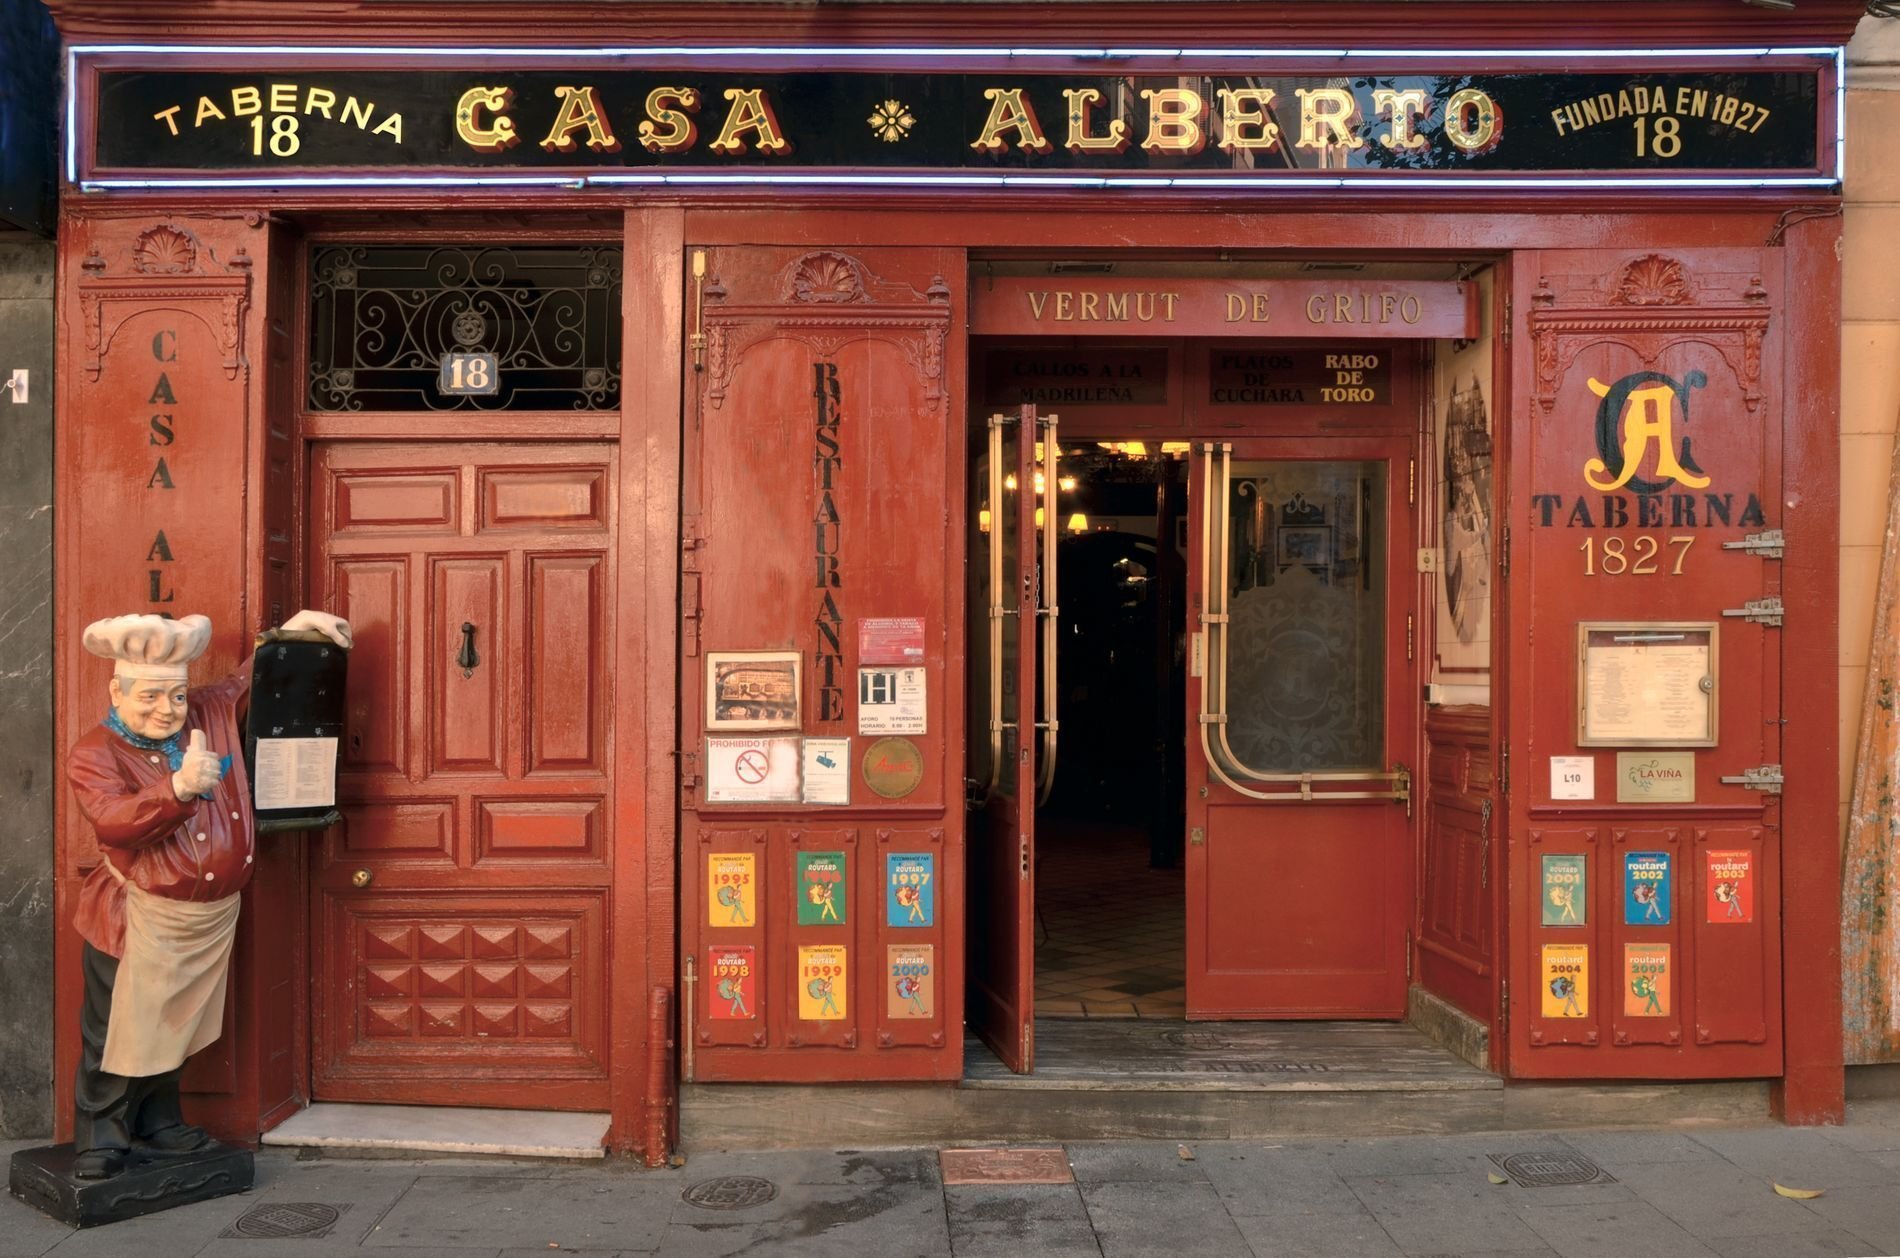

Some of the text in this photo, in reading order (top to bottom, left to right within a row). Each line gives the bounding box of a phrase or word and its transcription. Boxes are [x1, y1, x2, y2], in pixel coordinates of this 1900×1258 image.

[153, 84, 402, 144] TABERNA
[1551, 86, 1770, 136] FUNDADA EN 1827
[456, 86, 1503, 155] CASA ALBERTO
[250, 114, 300, 157] 18
[1633, 116, 1682, 158] 18
[1027, 291, 1423, 325] VERMUT DE GRIFO
[1325, 355, 1379, 370] RABO
[451, 358, 489, 389] 18
[1099, 363, 1113, 378] A
[1119, 363, 1142, 379] LA
[1336, 371, 1363, 385] DE
[1244, 373, 1270, 387] DE
[1214, 388, 1305, 402] CUCHARA
[1320, 388, 1375, 402] TORO
[146, 330, 178, 620] CASA AL
[1532, 492, 1766, 528] TABERNA
[813, 363, 844, 722] RESTAURANTE
[1580, 536, 1696, 576] 1827
[863, 673, 895, 704] H
[710, 740, 761, 748] PROHIBIDO
[1564, 774, 1581, 783] L10
[1641, 768, 1682, 778] LA VIÑA
[1628, 861, 1667, 870] routard
[1711, 862, 1749, 870] routard
[714, 874, 750, 885] 1995
[892, 873, 930, 885] 1997
[1546, 873, 1580, 884] 2001
[1632, 870, 1664, 880] 2002
[1715, 870, 1745, 879] 2003
[1546, 956, 1584, 964] routard
[1629, 956, 1666, 964] routard
[713, 965, 750, 977] 1998
[804, 966, 842, 977] 1999
[891, 964, 930, 977] 2000
[1551, 964, 1581, 973] 2004
